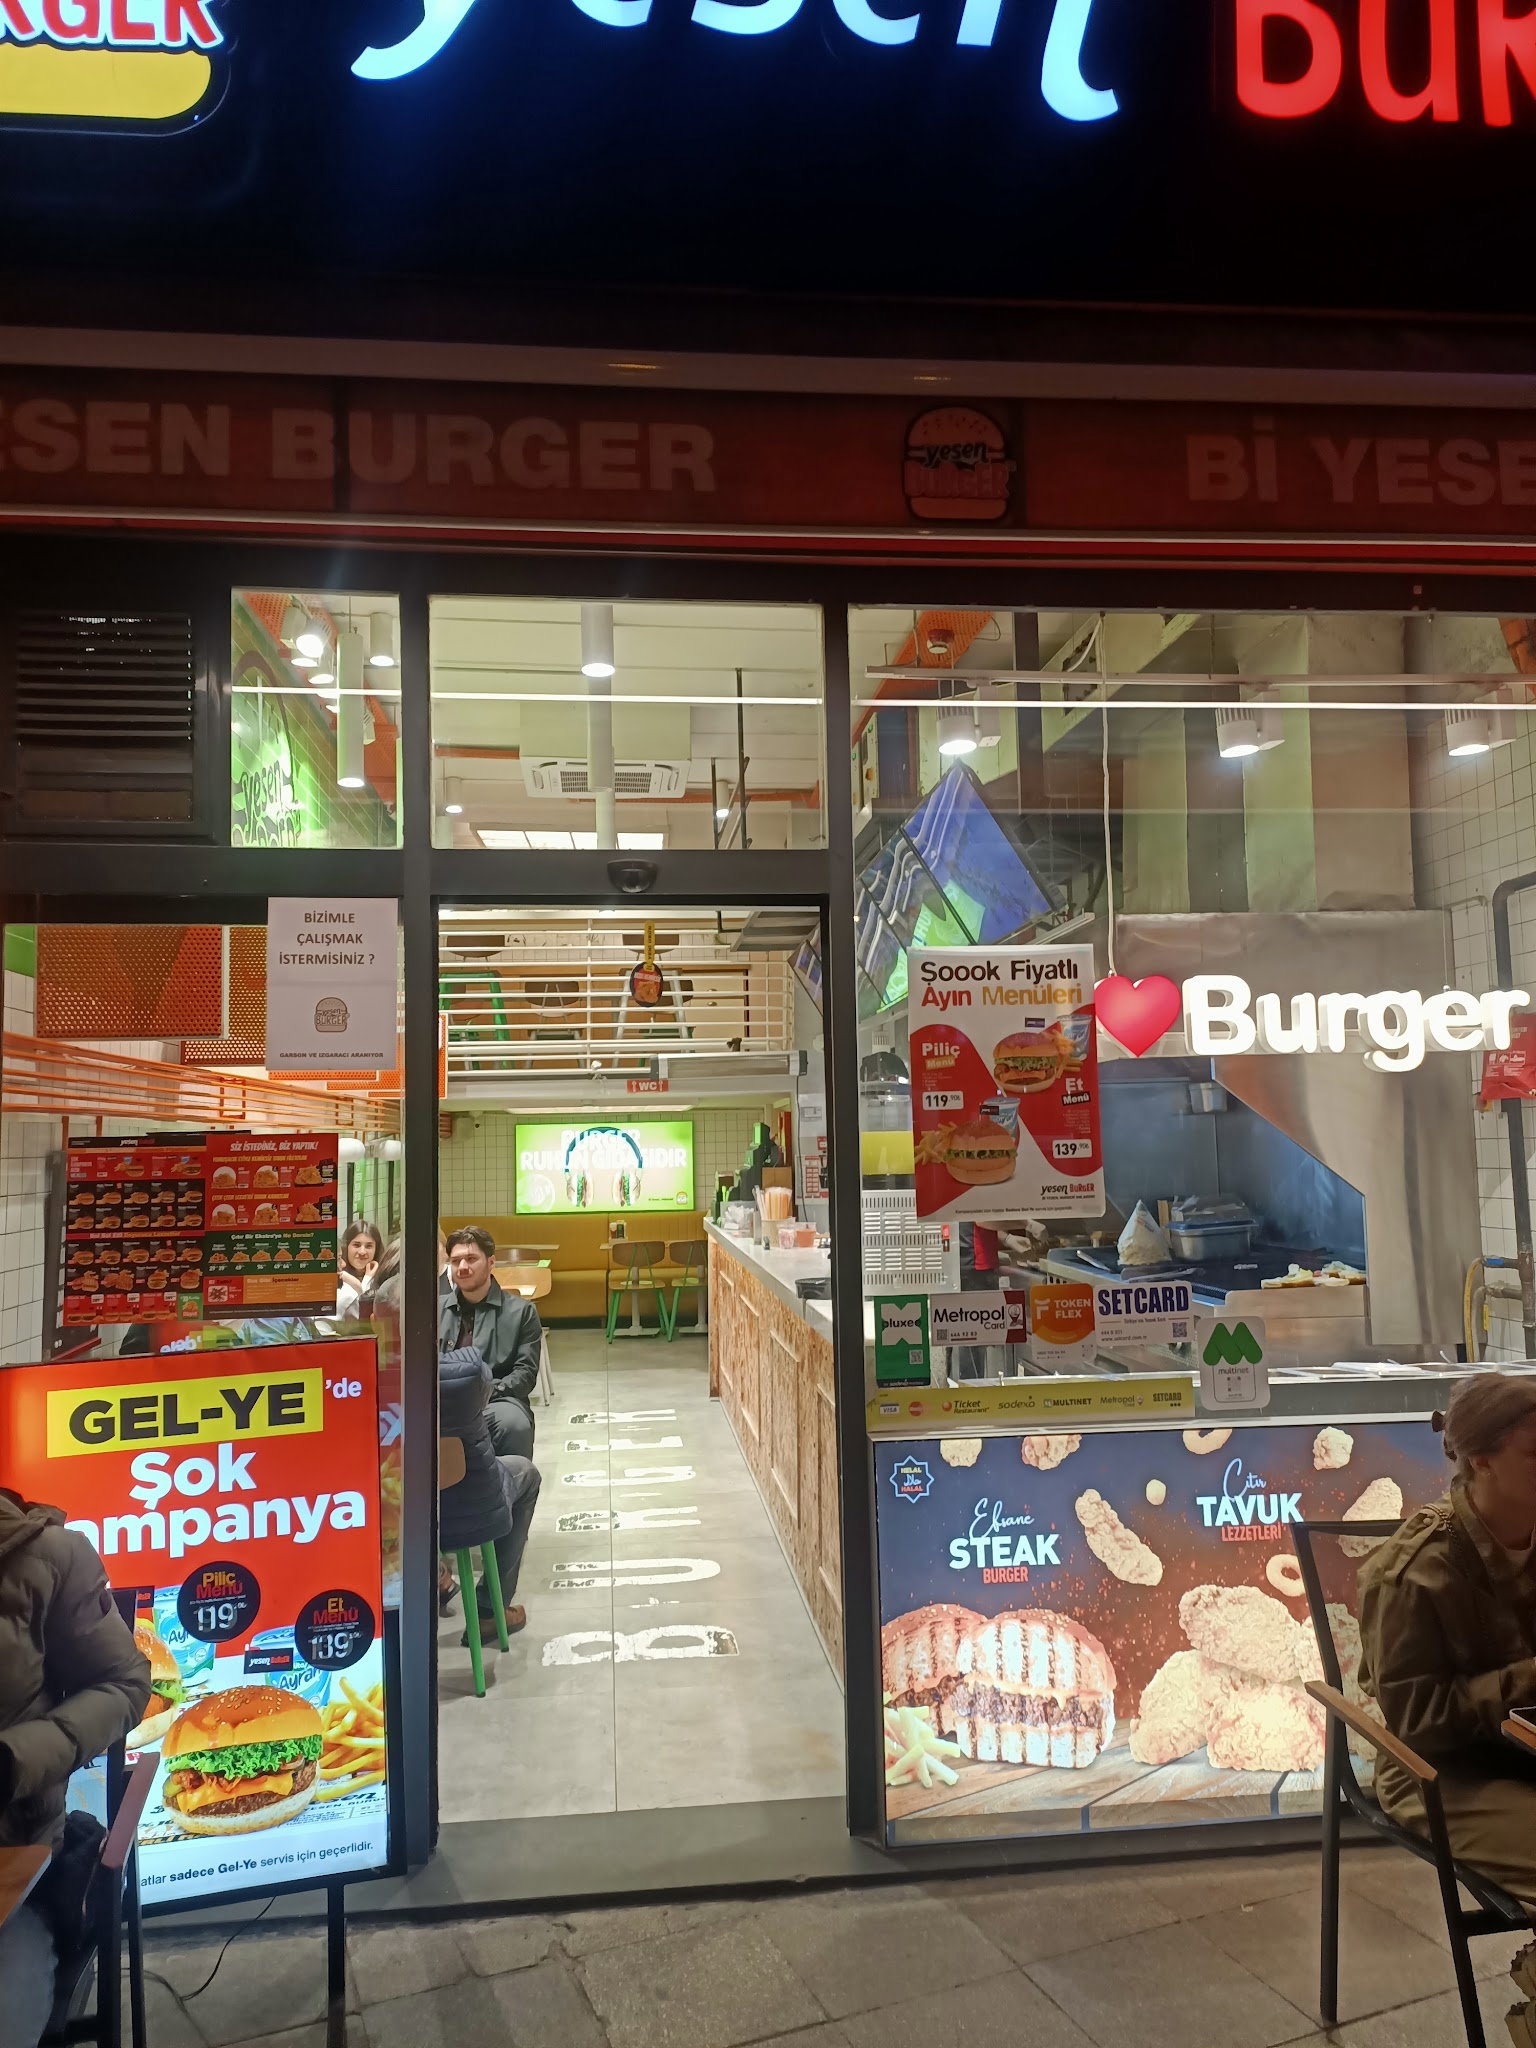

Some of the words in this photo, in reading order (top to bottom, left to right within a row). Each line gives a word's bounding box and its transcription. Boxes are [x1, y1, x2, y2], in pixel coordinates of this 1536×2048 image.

[0, 399, 231, 475] SEN
[271, 408, 715, 492] BURGER
[924, 443, 989, 469] yesen
[304, 910, 355, 924] BİZİMLE
[296, 933, 363, 946] ÇALIŞMAK
[279, 951, 365, 965] İSTERMİSİNİZ
[368, 953, 375, 965] ?
[920, 960, 1001, 986] Şoook
[1010, 959, 1079, 985] Fiyatlı
[920, 986, 972, 1012] Ayın
[982, 982, 1083, 1007] Menüleri
[1182, 973, 1531, 1074] Burger
[921, 1042, 961, 1059] Piliç
[638, 1080, 657, 1091] WC
[1065, 1077, 1084, 1092] Et
[1062, 1093, 1090, 1105] Menü
[1040, 1184, 1068, 1196] yesen
[1054, 1298, 1091, 1308] TOKEN
[1097, 1285, 1189, 1316] SETCARD
[933, 1306, 1005, 1325] Metropol
[1055, 1309, 1082, 1319] FLEX
[983, 1321, 1006, 1330] Card
[1218, 1366, 1249, 1375] multinet
[953, 1400, 981, 1408] Ticket
[998, 1398, 1036, 1410] sodexo
[1052, 1398, 1092, 1407] MULTINET
[1152, 1392, 1183, 1402] SETCARD
[68, 1381, 306, 1445] GEL-YE
[129, 1442, 257, 1510] Şok
[900, 1466, 923, 1474] HELAL
[1195, 1492, 1305, 1527] TAVUK
[64, 1489, 366, 1558] ampanya
[1221, 1522, 1282, 1542] LEZZETLERİ
[949, 1533, 1062, 1570] STEAK
[982, 1566, 1030, 1585] BURGER
[327, 1597, 344, 1613] Et
[168, 1865, 215, 1883] sadece
[217, 1858, 258, 1877] Gel-Ye
[260, 1853, 295, 1867] servis
[296, 1848, 317, 1864] için
[318, 1840, 375, 1859] geçerlidir.
